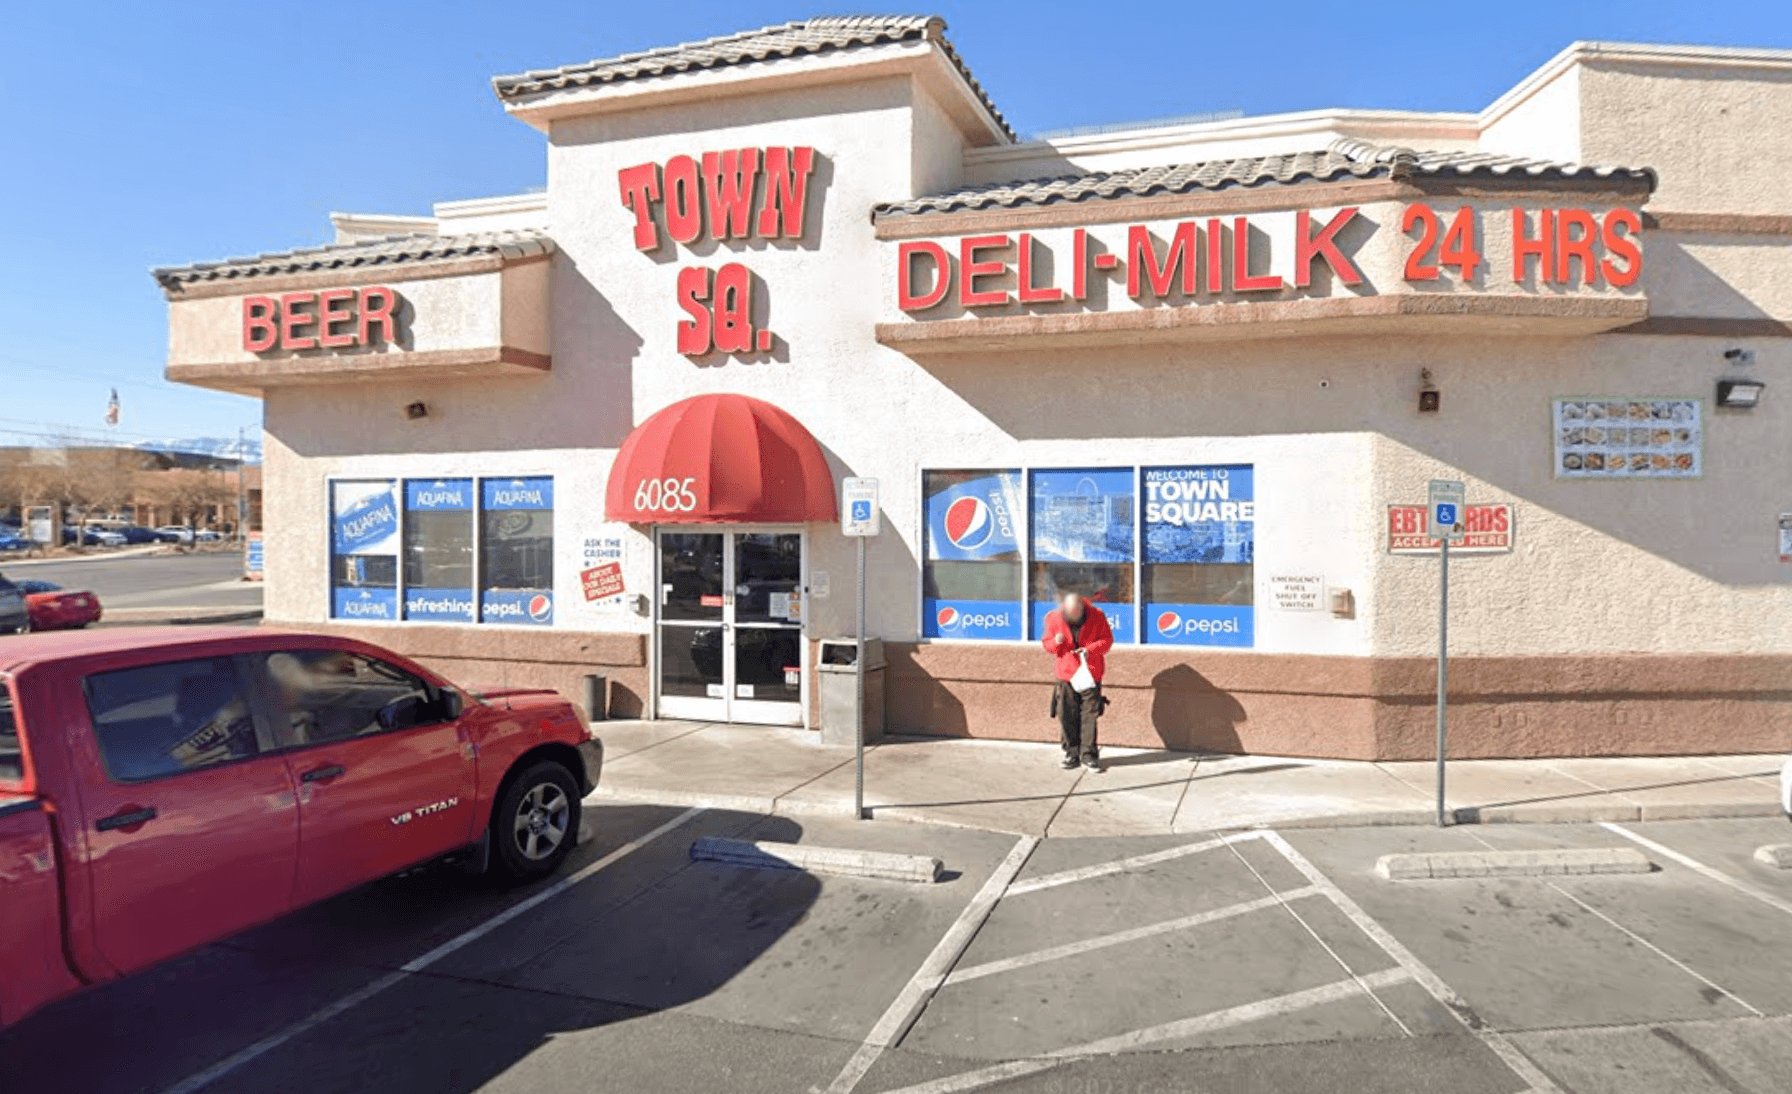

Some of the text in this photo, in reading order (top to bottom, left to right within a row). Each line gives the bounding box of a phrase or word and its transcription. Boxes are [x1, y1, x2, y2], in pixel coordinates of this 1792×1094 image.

[618, 146, 815, 252] TOWN
[1403, 203, 1642, 288] 24 HRS
[898, 206, 1362, 312] DELI-MILK
[243, 285, 398, 353] BEER
[677, 262, 771, 356] SQ.
[1147, 469, 1229, 481] WELCOME TO
[417, 490, 464, 507] AQUAFINA
[493, 489, 543, 506] AQUAFINA
[634, 478, 697, 512] 6085
[1146, 479, 1229, 501] TOWN
[343, 504, 395, 543] AQUAFINA
[989, 490, 1014, 538] pepsi
[1146, 501, 1254, 526] SQUARE
[1390, 506, 1428, 534] EBT
[584, 538, 621, 548] ASK THE
[1468, 534, 1507, 546] HERE
[584, 549, 621, 558] CASHIER
[1275, 592, 1297, 600] SHUT
[1284, 584, 1306, 592] FUEL
[344, 601, 390, 618] AQUAFINA
[962, 611, 1011, 629] pepsi
[1185, 616, 1239, 636] pepsi
[415, 797, 458, 817] TITAN
